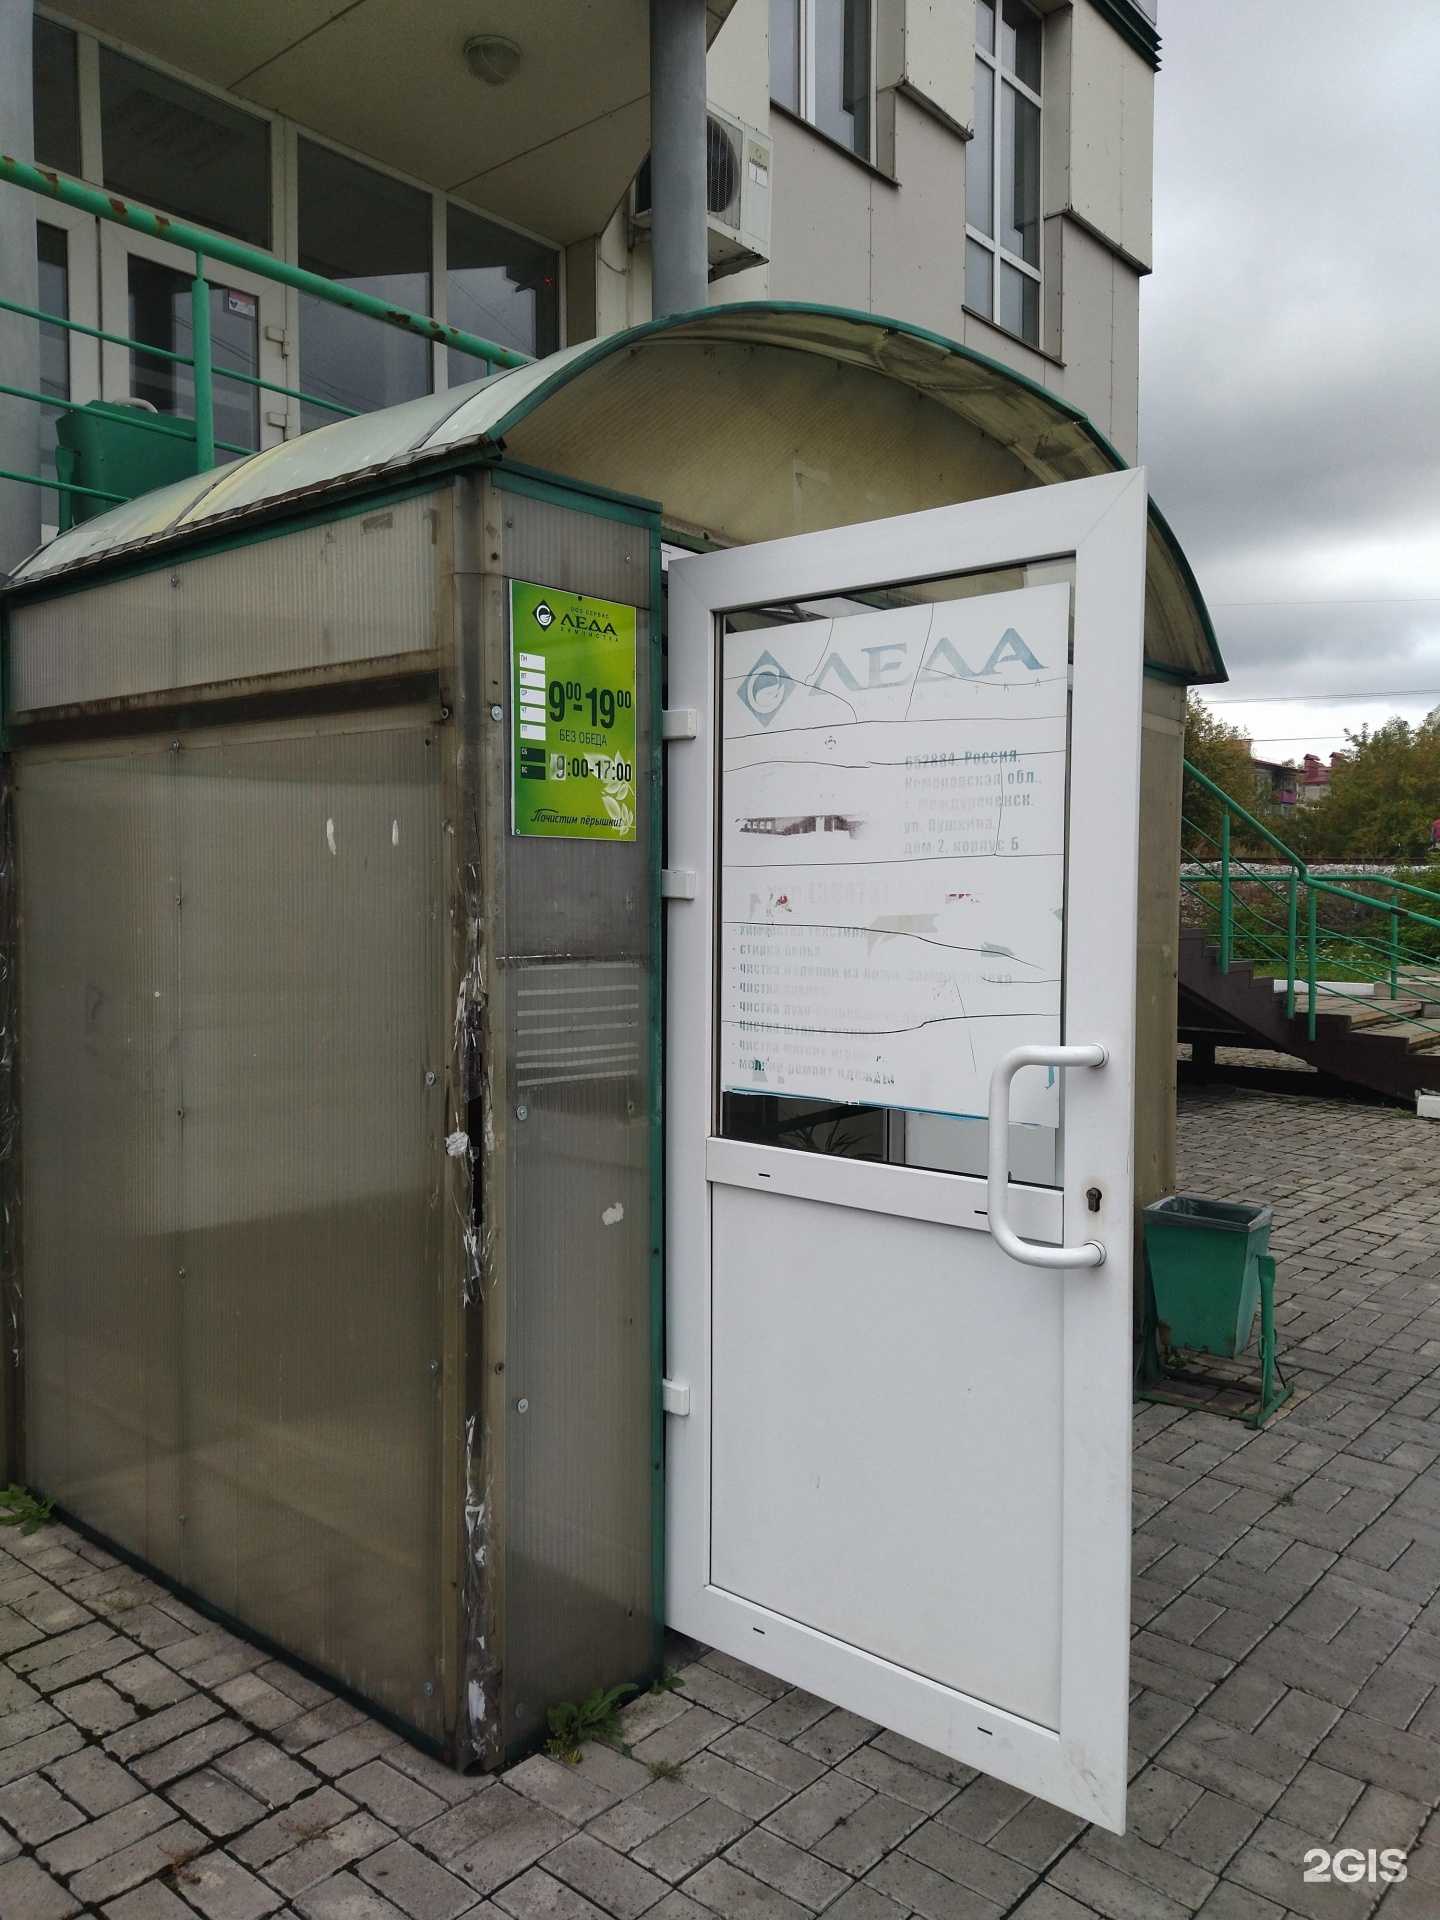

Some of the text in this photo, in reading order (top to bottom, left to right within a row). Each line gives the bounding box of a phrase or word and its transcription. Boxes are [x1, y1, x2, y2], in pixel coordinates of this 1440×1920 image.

[560, 613, 617, 636] ЛЕДА
[559, 728, 608, 748] БЕЗ ОБЕДА
[530, 807, 578, 825] Почистим
